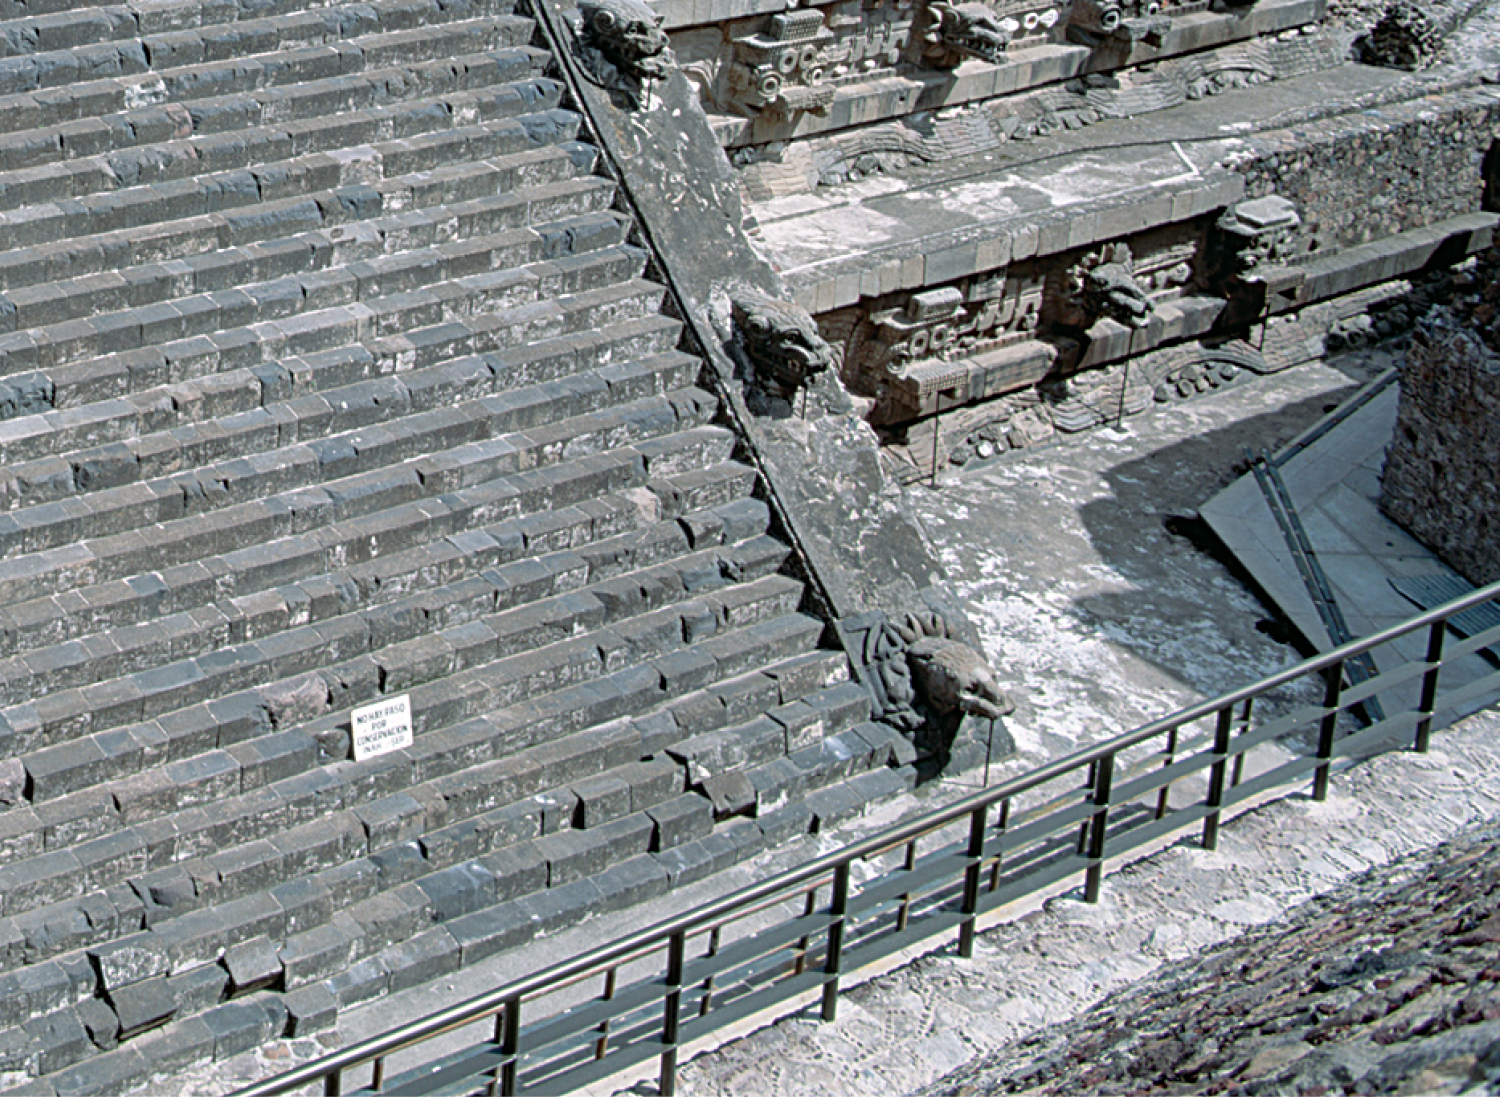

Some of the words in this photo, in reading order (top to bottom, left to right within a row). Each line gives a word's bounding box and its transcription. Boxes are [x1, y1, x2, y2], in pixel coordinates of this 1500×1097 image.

[357, 714, 367, 724] NO
[368, 709, 383, 719] HAY
[384, 703, 405, 716] PASO
[371, 719, 387, 731] POR
